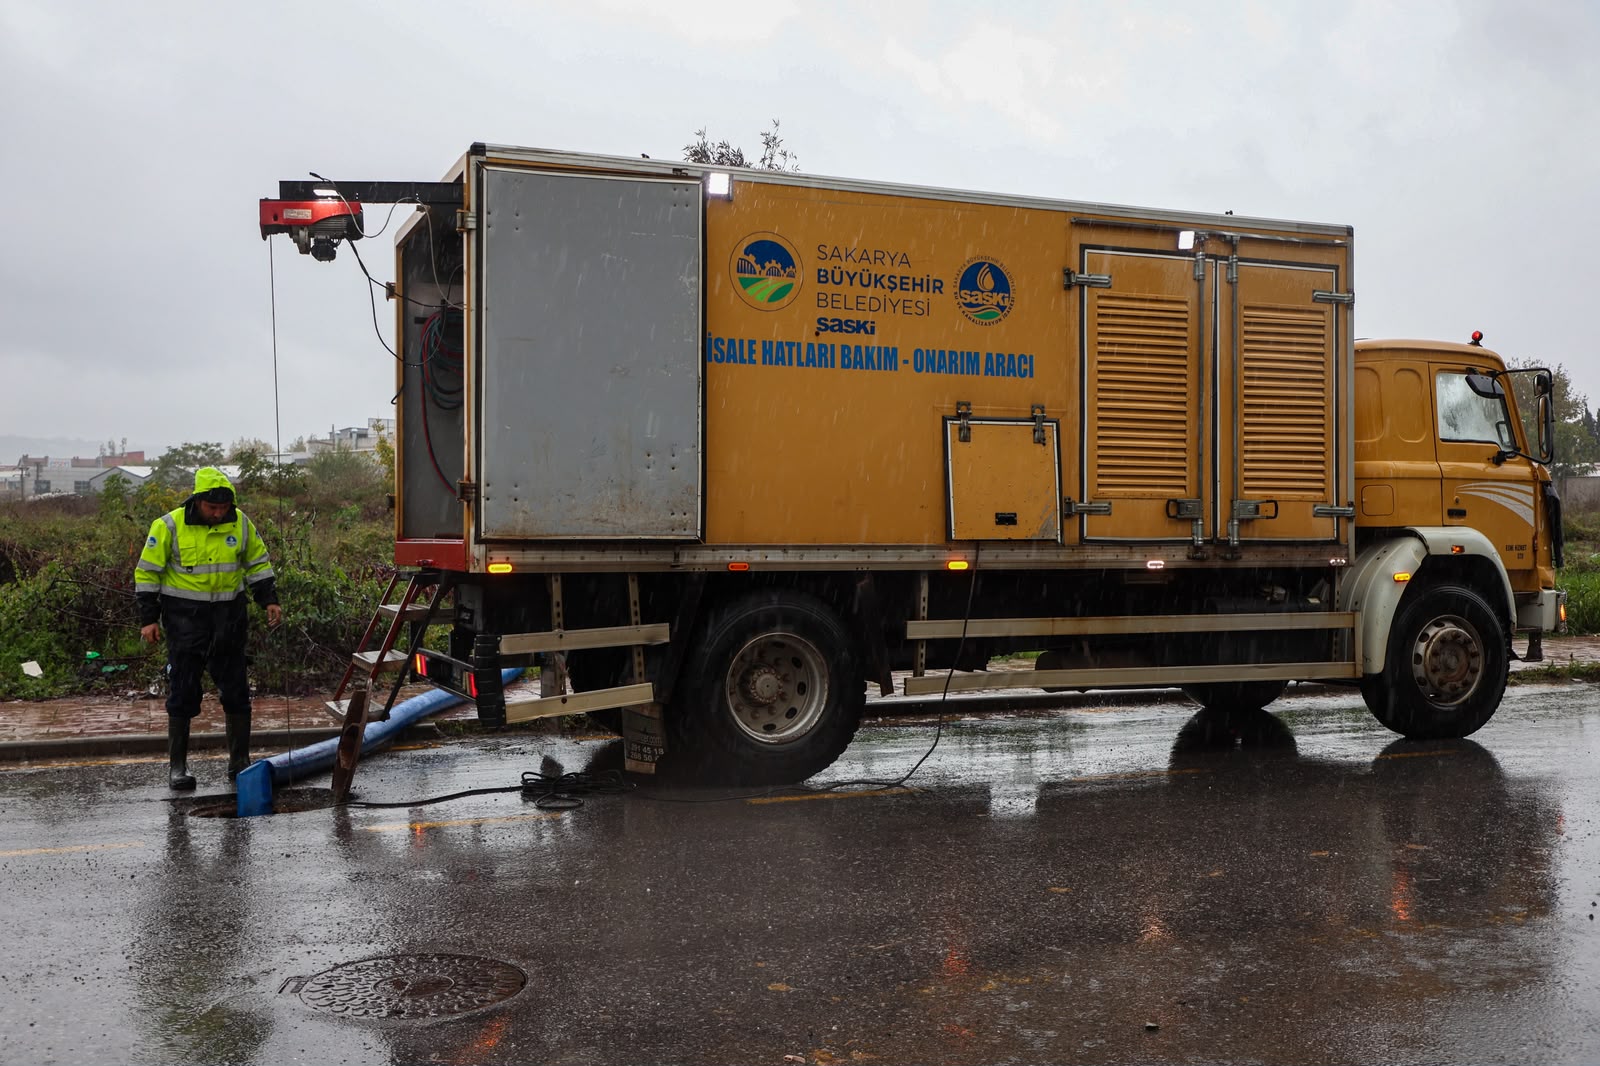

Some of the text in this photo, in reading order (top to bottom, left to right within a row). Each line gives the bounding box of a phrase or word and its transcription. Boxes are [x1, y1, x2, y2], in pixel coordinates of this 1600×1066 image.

[817, 244, 911, 269] SAKARYA
[817, 267, 944, 295] BÜYÜKŞEHİR
[817, 291, 931, 317] BELEDİYESİ
[707, 331, 757, 365] İSALE
[762, 338, 836, 369] HATLARI
[840, 344, 898, 372] BAKIM
[913, 347, 980, 376] ONARIM
[984, 352, 1034, 379] ARACI
